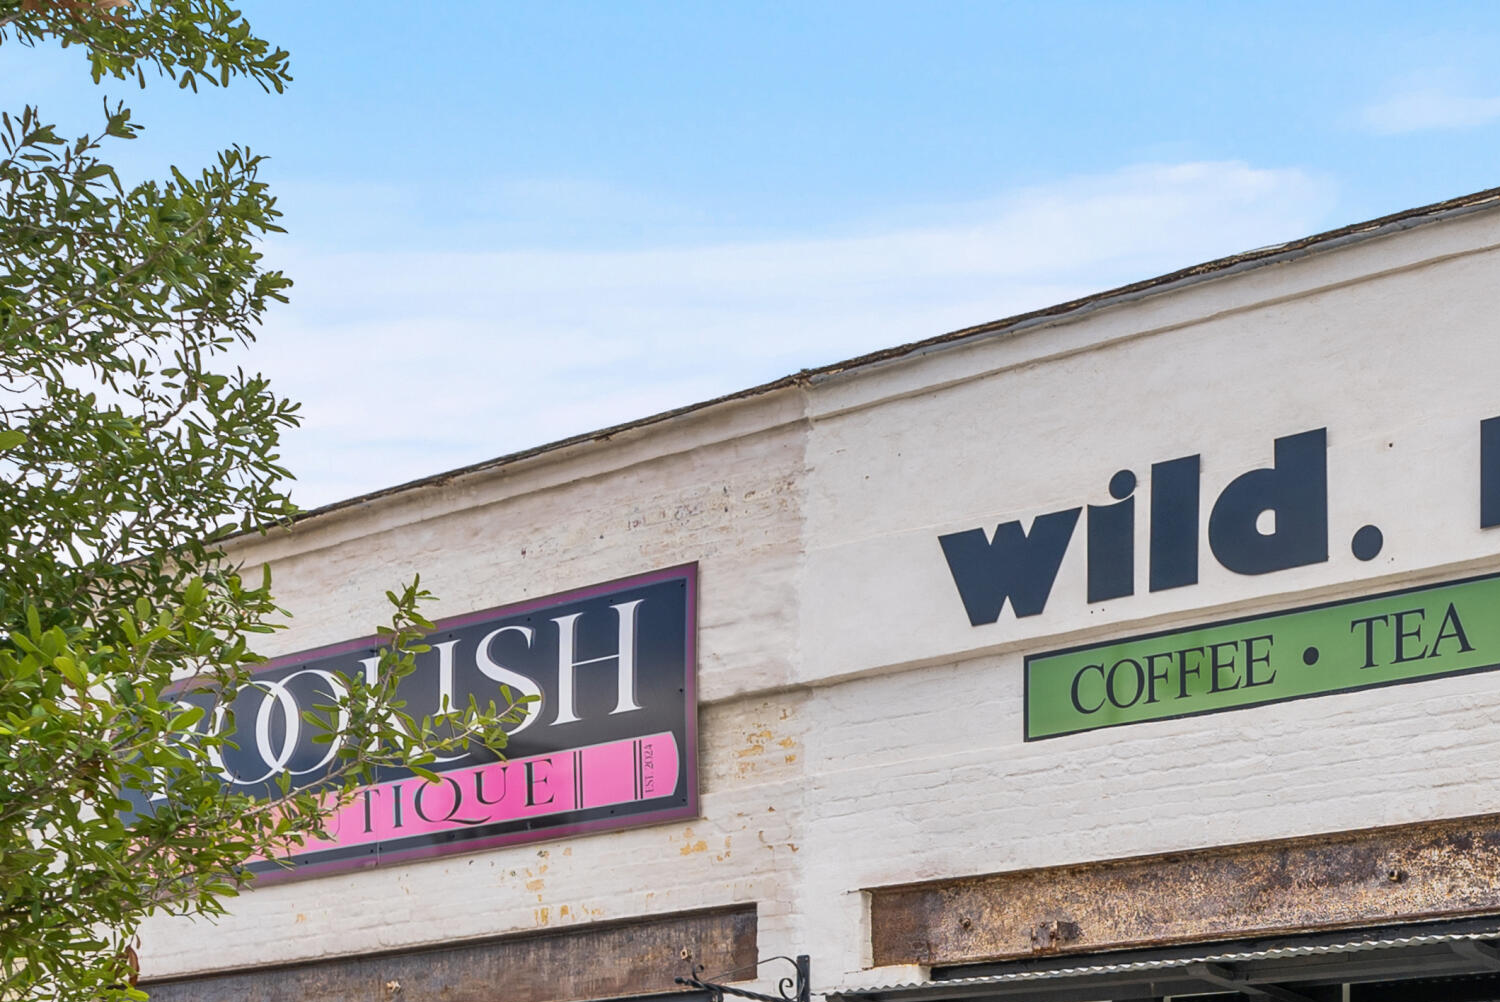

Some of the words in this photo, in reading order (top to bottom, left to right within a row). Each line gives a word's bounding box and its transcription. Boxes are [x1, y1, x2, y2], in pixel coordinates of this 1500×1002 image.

[937, 426, 1384, 627] wild.
[1070, 633, 1277, 716] COFFEE
[1350, 602, 1475, 671] TEA
[333, 758, 555, 834] TIQUE
